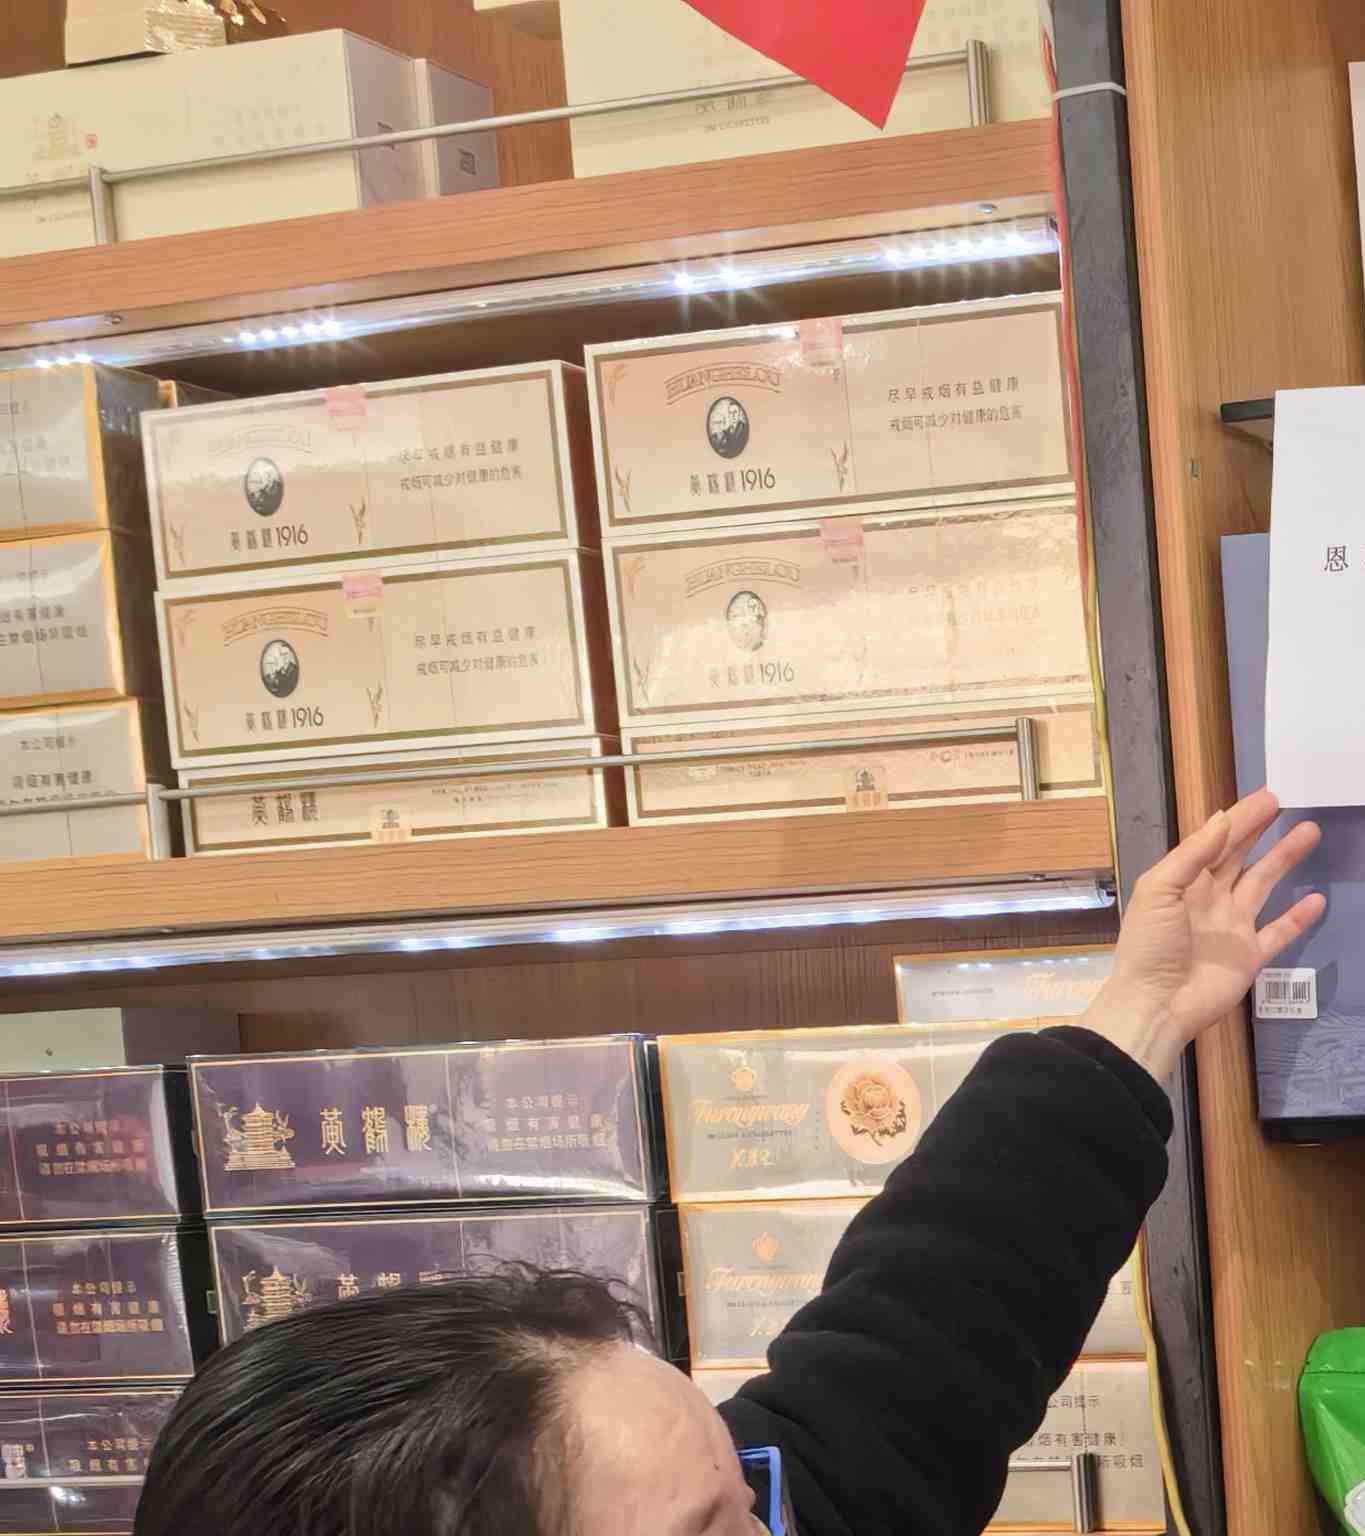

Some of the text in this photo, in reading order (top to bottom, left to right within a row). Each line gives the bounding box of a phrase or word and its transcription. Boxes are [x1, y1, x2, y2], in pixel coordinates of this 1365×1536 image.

[887, 376, 1021, 403] 尽早戒烟有益健康
[1027, 1432, 1117, 1448] 烟有害健康
